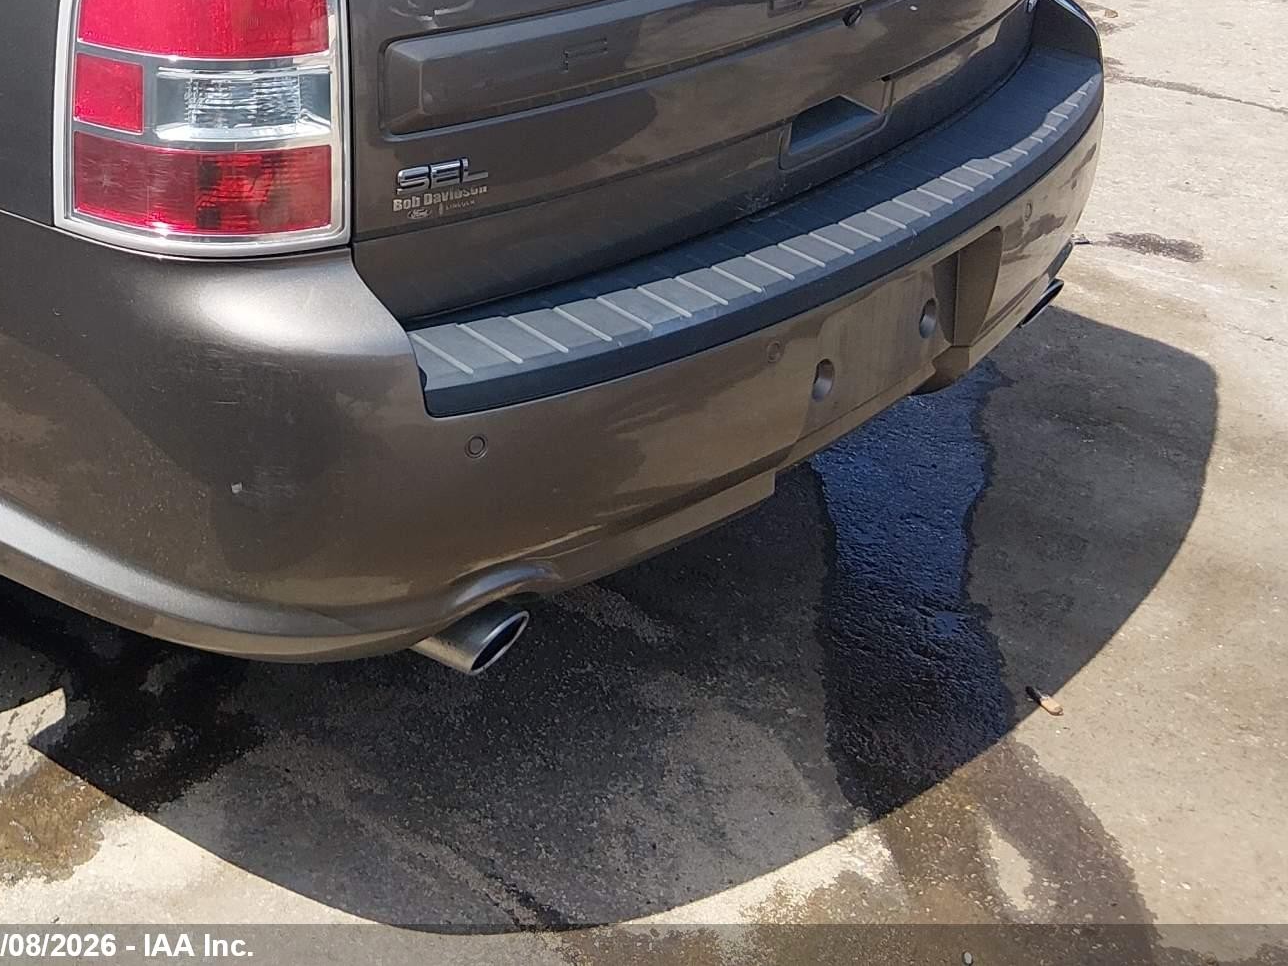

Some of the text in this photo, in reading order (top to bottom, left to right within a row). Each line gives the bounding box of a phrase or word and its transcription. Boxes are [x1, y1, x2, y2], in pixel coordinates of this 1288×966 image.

[396, 158, 489, 195] SEL
[393, 185, 488, 212] Bob Davidson
